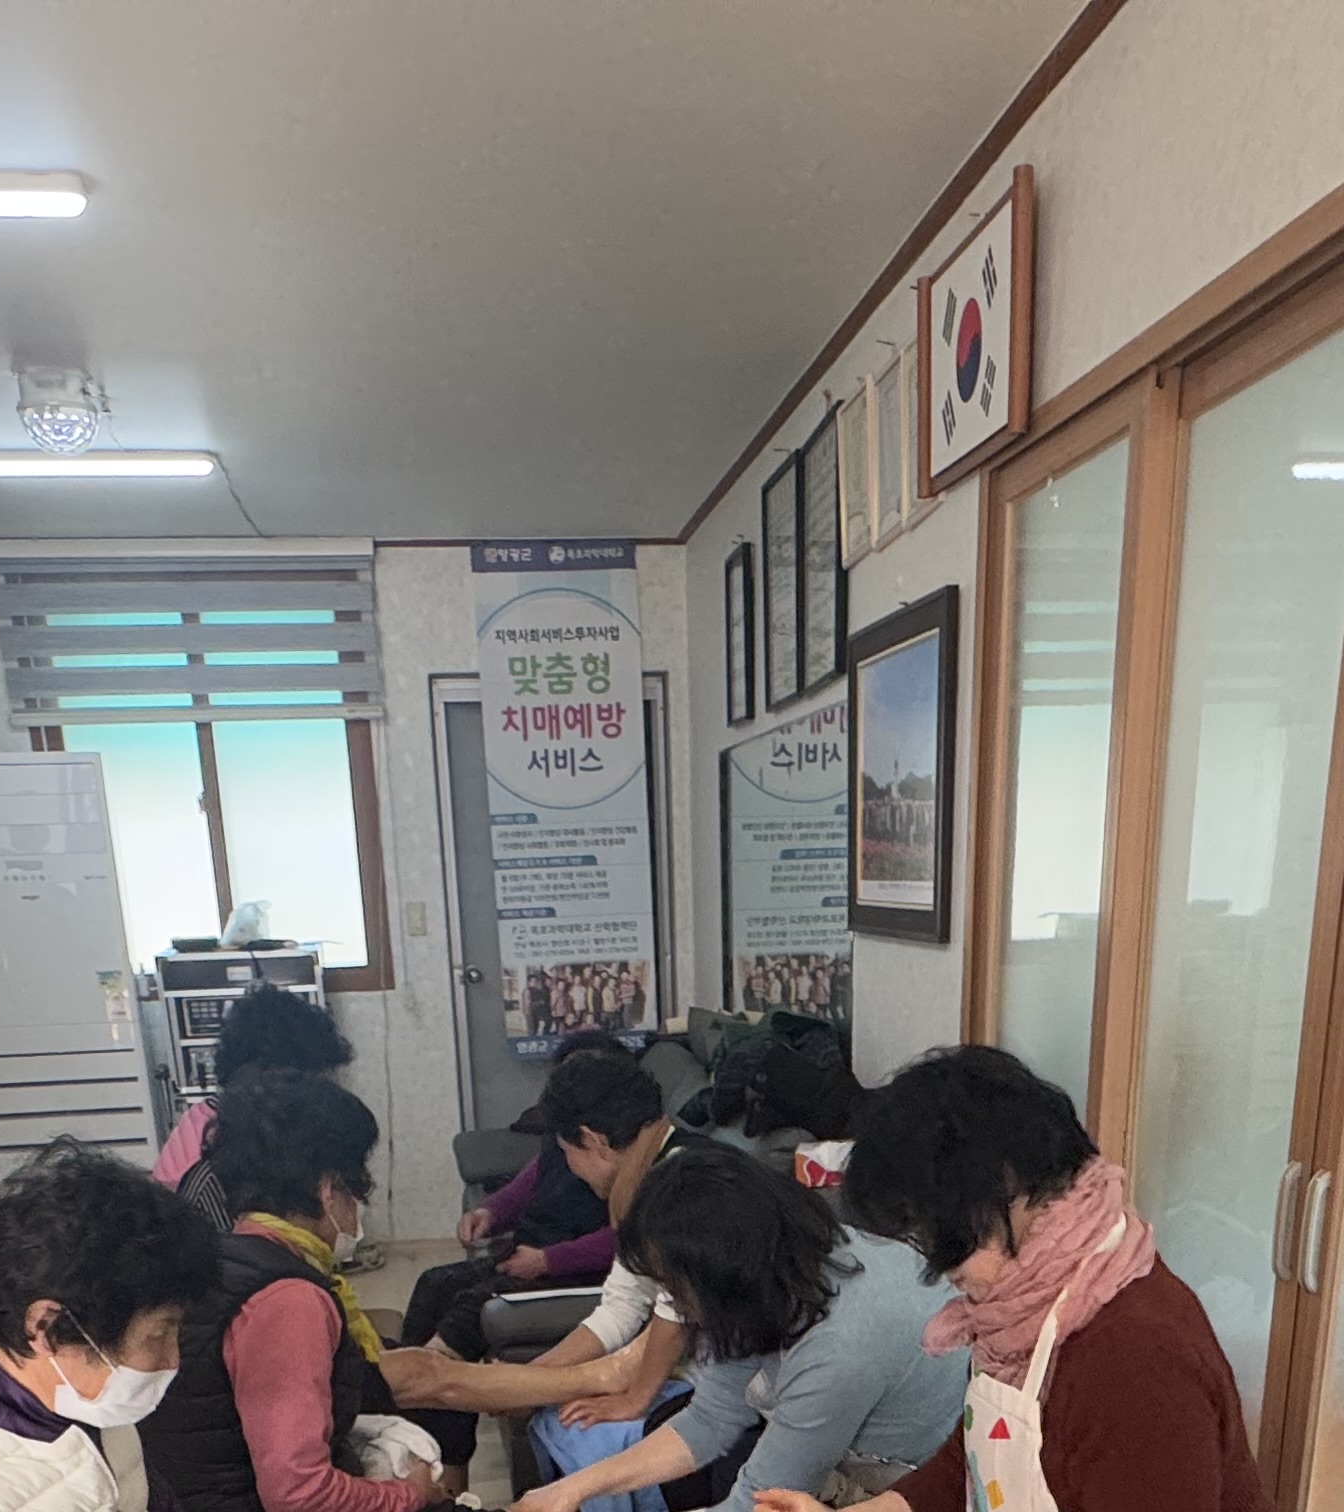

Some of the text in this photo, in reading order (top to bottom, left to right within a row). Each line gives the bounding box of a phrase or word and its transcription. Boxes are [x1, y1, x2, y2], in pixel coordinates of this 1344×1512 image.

[495, 626, 620, 644] 지역사회서비스투자사업
[508, 652, 611, 695] 맞춤형
[501, 702, 626, 742] 치매예방
[527, 747, 604, 778] 서비스
